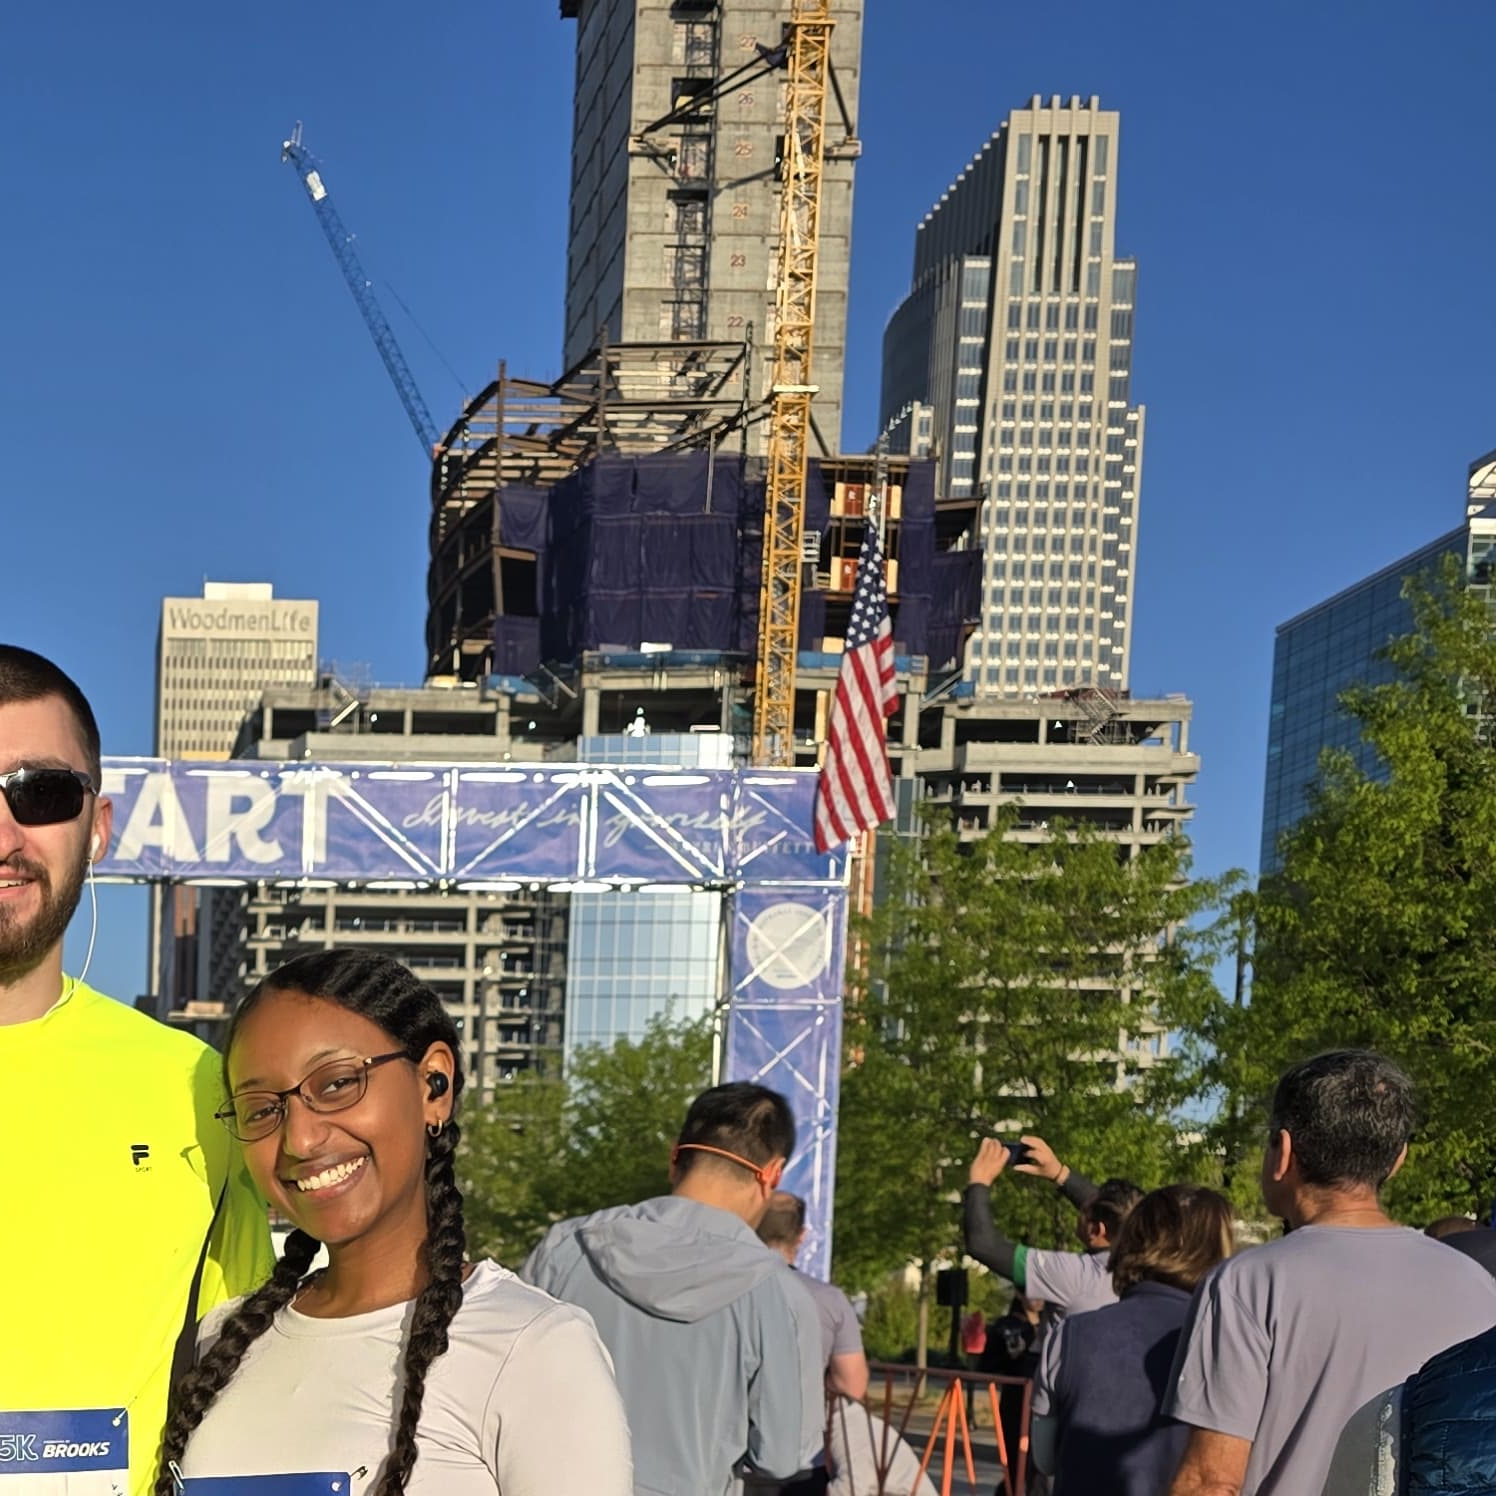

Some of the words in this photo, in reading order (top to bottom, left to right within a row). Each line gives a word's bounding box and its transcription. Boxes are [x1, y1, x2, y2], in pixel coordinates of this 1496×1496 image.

[740, 36, 756, 48] 27
[735, 144, 752, 156] 25
[732, 205, 748, 218] 24
[730, 255, 746, 267] 23
[727, 316, 744, 328] 22
[169, 607, 311, 632] WoodmenLife
[101, 771, 352, 864] ART
[42, 1441, 111, 1459] BROOKS
